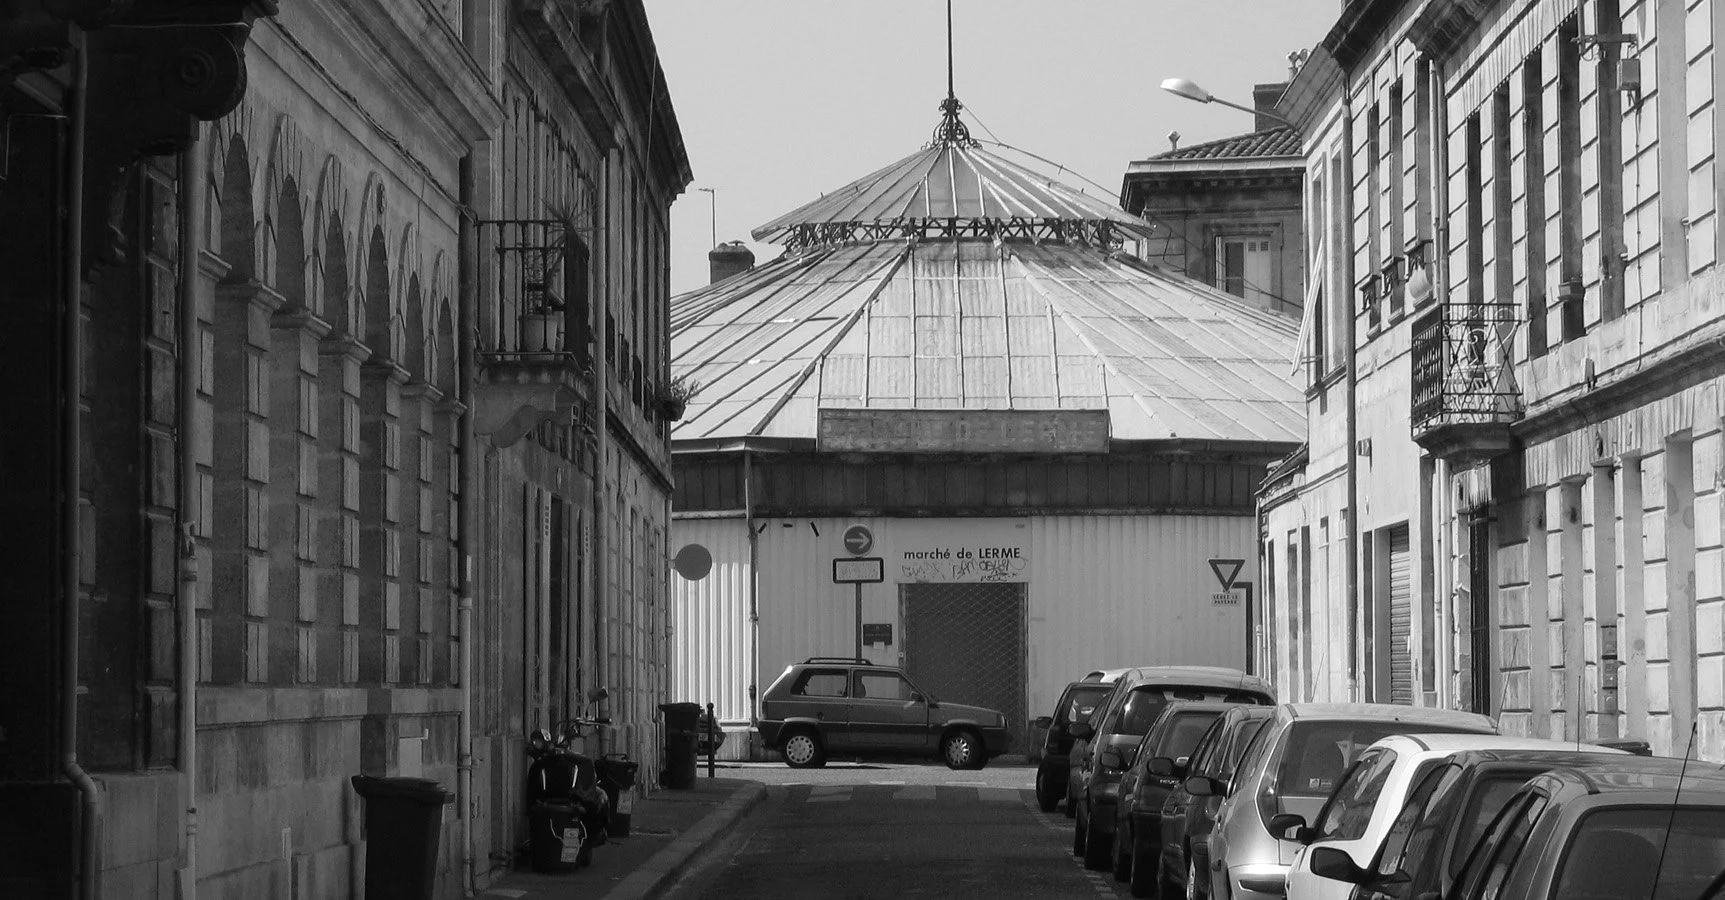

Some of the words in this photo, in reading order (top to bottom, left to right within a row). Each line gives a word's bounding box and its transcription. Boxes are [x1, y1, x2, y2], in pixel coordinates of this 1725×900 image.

[904, 548, 951, 559] marché
[956, 547, 973, 559] de
[979, 548, 1020, 559] LERME
